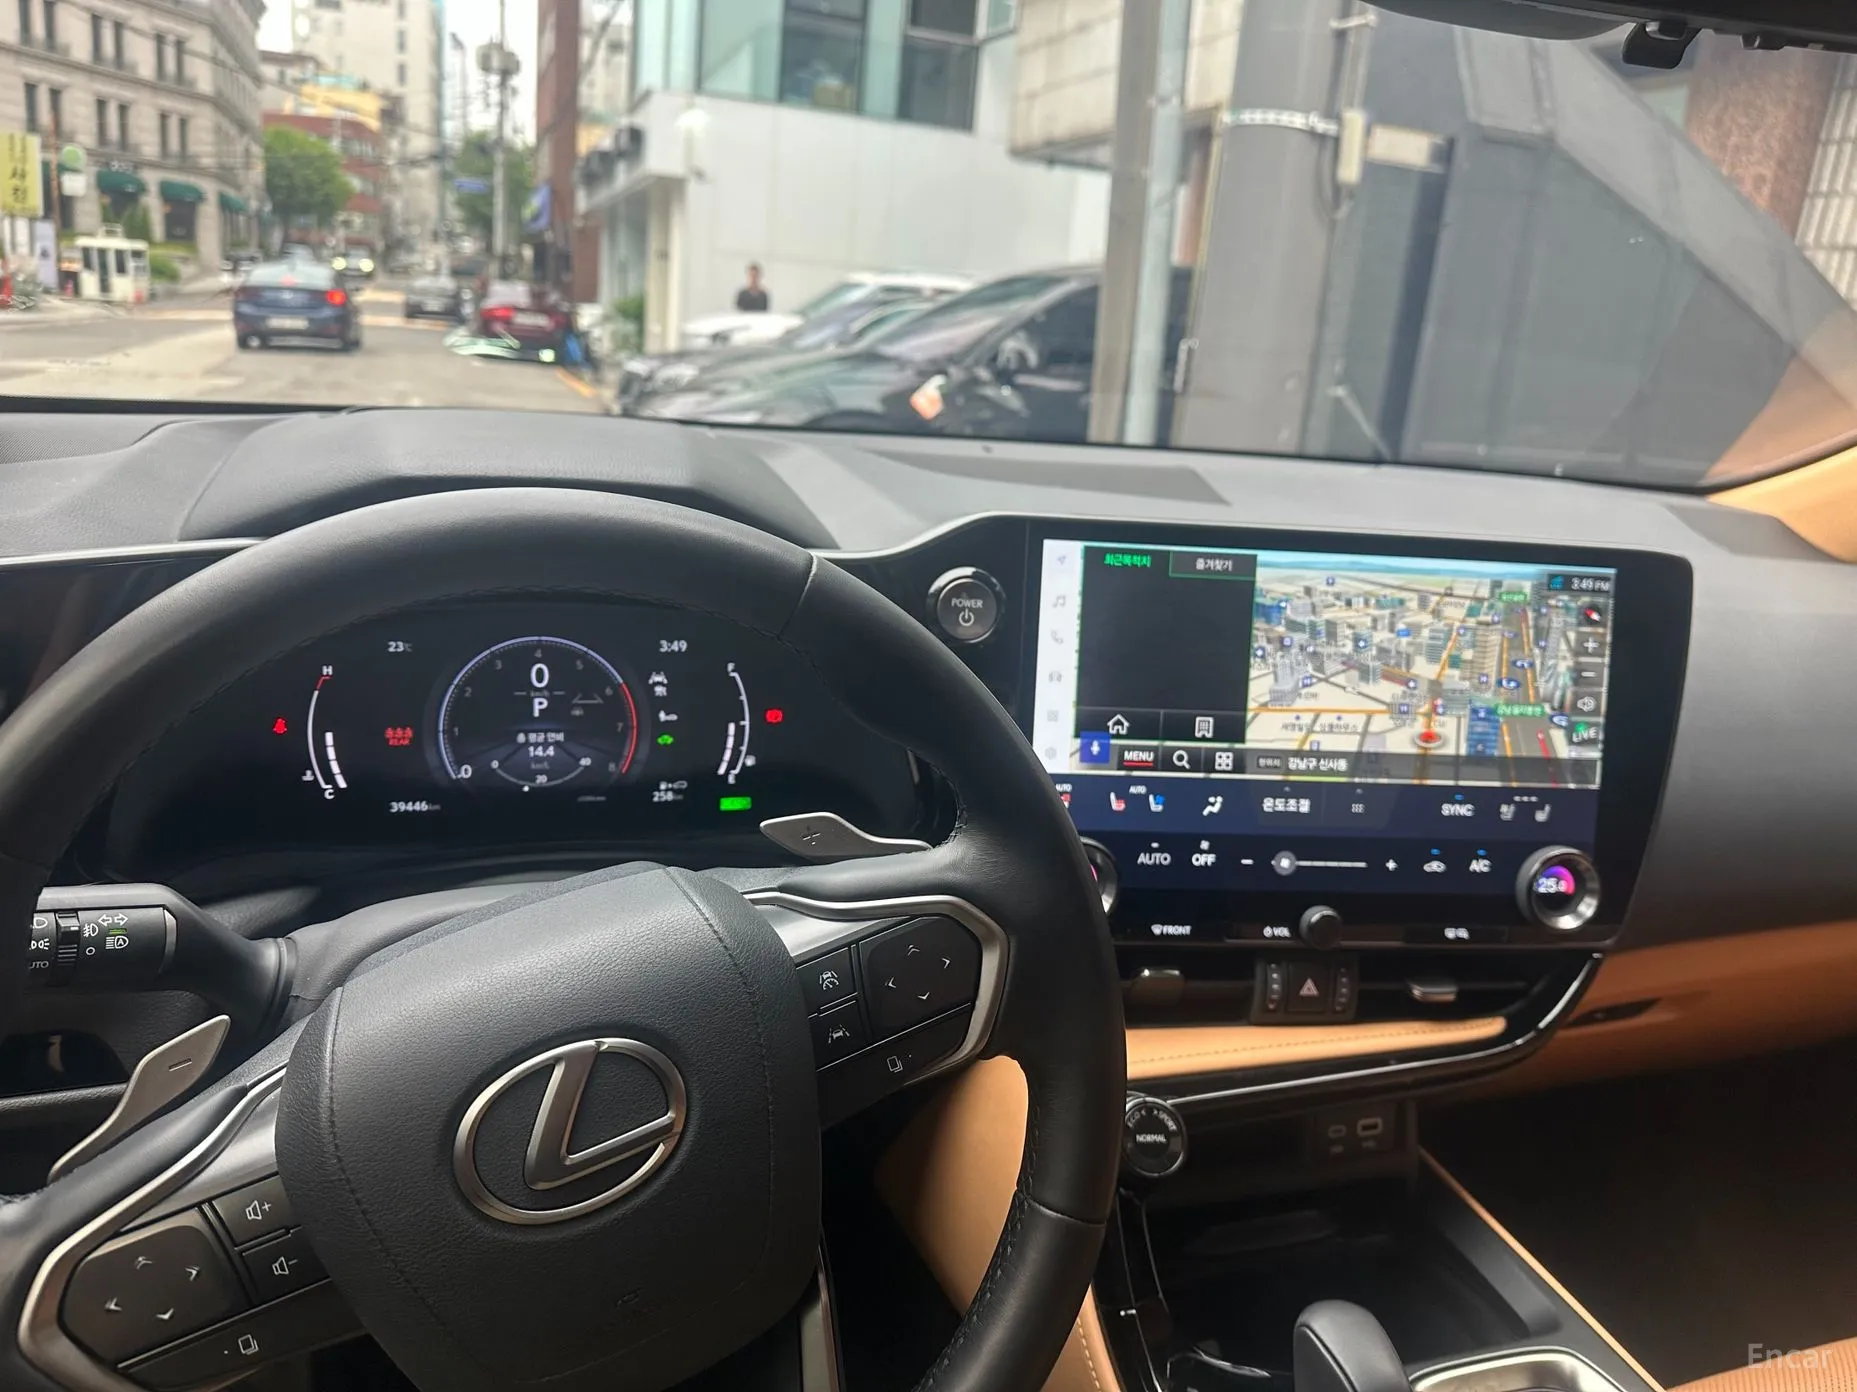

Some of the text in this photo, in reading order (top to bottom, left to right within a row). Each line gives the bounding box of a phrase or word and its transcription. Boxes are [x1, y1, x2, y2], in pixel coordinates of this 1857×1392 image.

[1195, 558, 1233, 572] 즐겨찾기
[951, 598, 983, 608] POWER
[660, 640, 688, 652] 3:49
[535, 649, 542, 658] 4
[322, 665, 333, 676] H
[495, 660, 502, 670] 3
[727, 662, 735, 672] F
[530, 663, 549, 688] 0
[464, 688, 472, 698] 2
[533, 698, 548, 717] P
[616, 722, 623, 732] 7
[528, 732, 545, 743] 평균
[547, 732, 564, 742] 연비
[1572, 728, 1598, 742] LIVE
[528, 746, 554, 757] 14.4
[1124, 750, 1154, 761] MENU
[491, 760, 499, 768] 0
[579, 758, 592, 767] 40
[1288, 757, 1317, 771] 강남구
[1319, 758, 1348, 772] 신사동
[324, 789, 335, 799] C
[1129, 785, 1147, 795] AUTO
[1262, 797, 1311, 814] 온도조절
[1441, 804, 1475, 817] SYNC
[1137, 852, 1171, 866] AUTO
[1192, 853, 1216, 867] OFF
[1163, 925, 1192, 936] FRONT
[1273, 926, 1292, 938] VOL
[1158, 1110, 1178, 1132] SPORT
[1136, 1133, 1166, 1144] NORMAL
